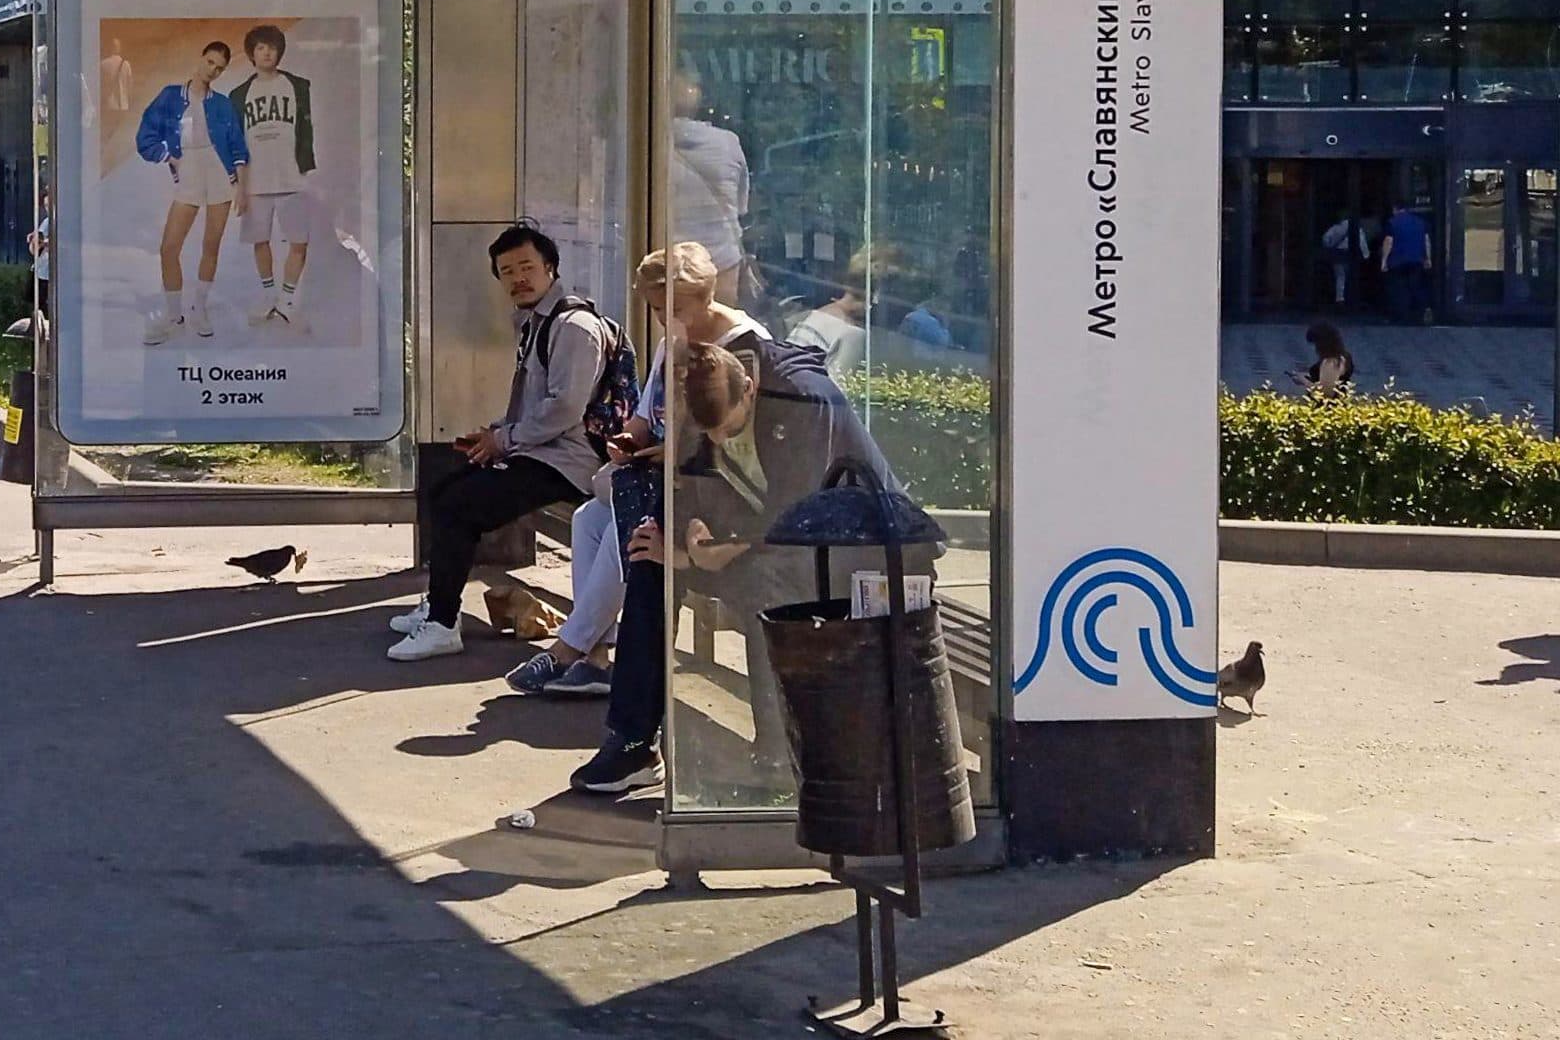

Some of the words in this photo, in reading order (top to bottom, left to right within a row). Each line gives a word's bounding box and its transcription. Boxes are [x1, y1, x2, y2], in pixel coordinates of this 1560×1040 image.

[1129, 54, 1152, 135] Metro
[246, 95, 294, 130] REAL
[1088, 218, 1124, 339] Метро
[178, 367, 203, 384] ТЦ
[208, 366, 287, 382] Океания
[201, 390, 213, 405] 2
[218, 391, 264, 405] этаж
